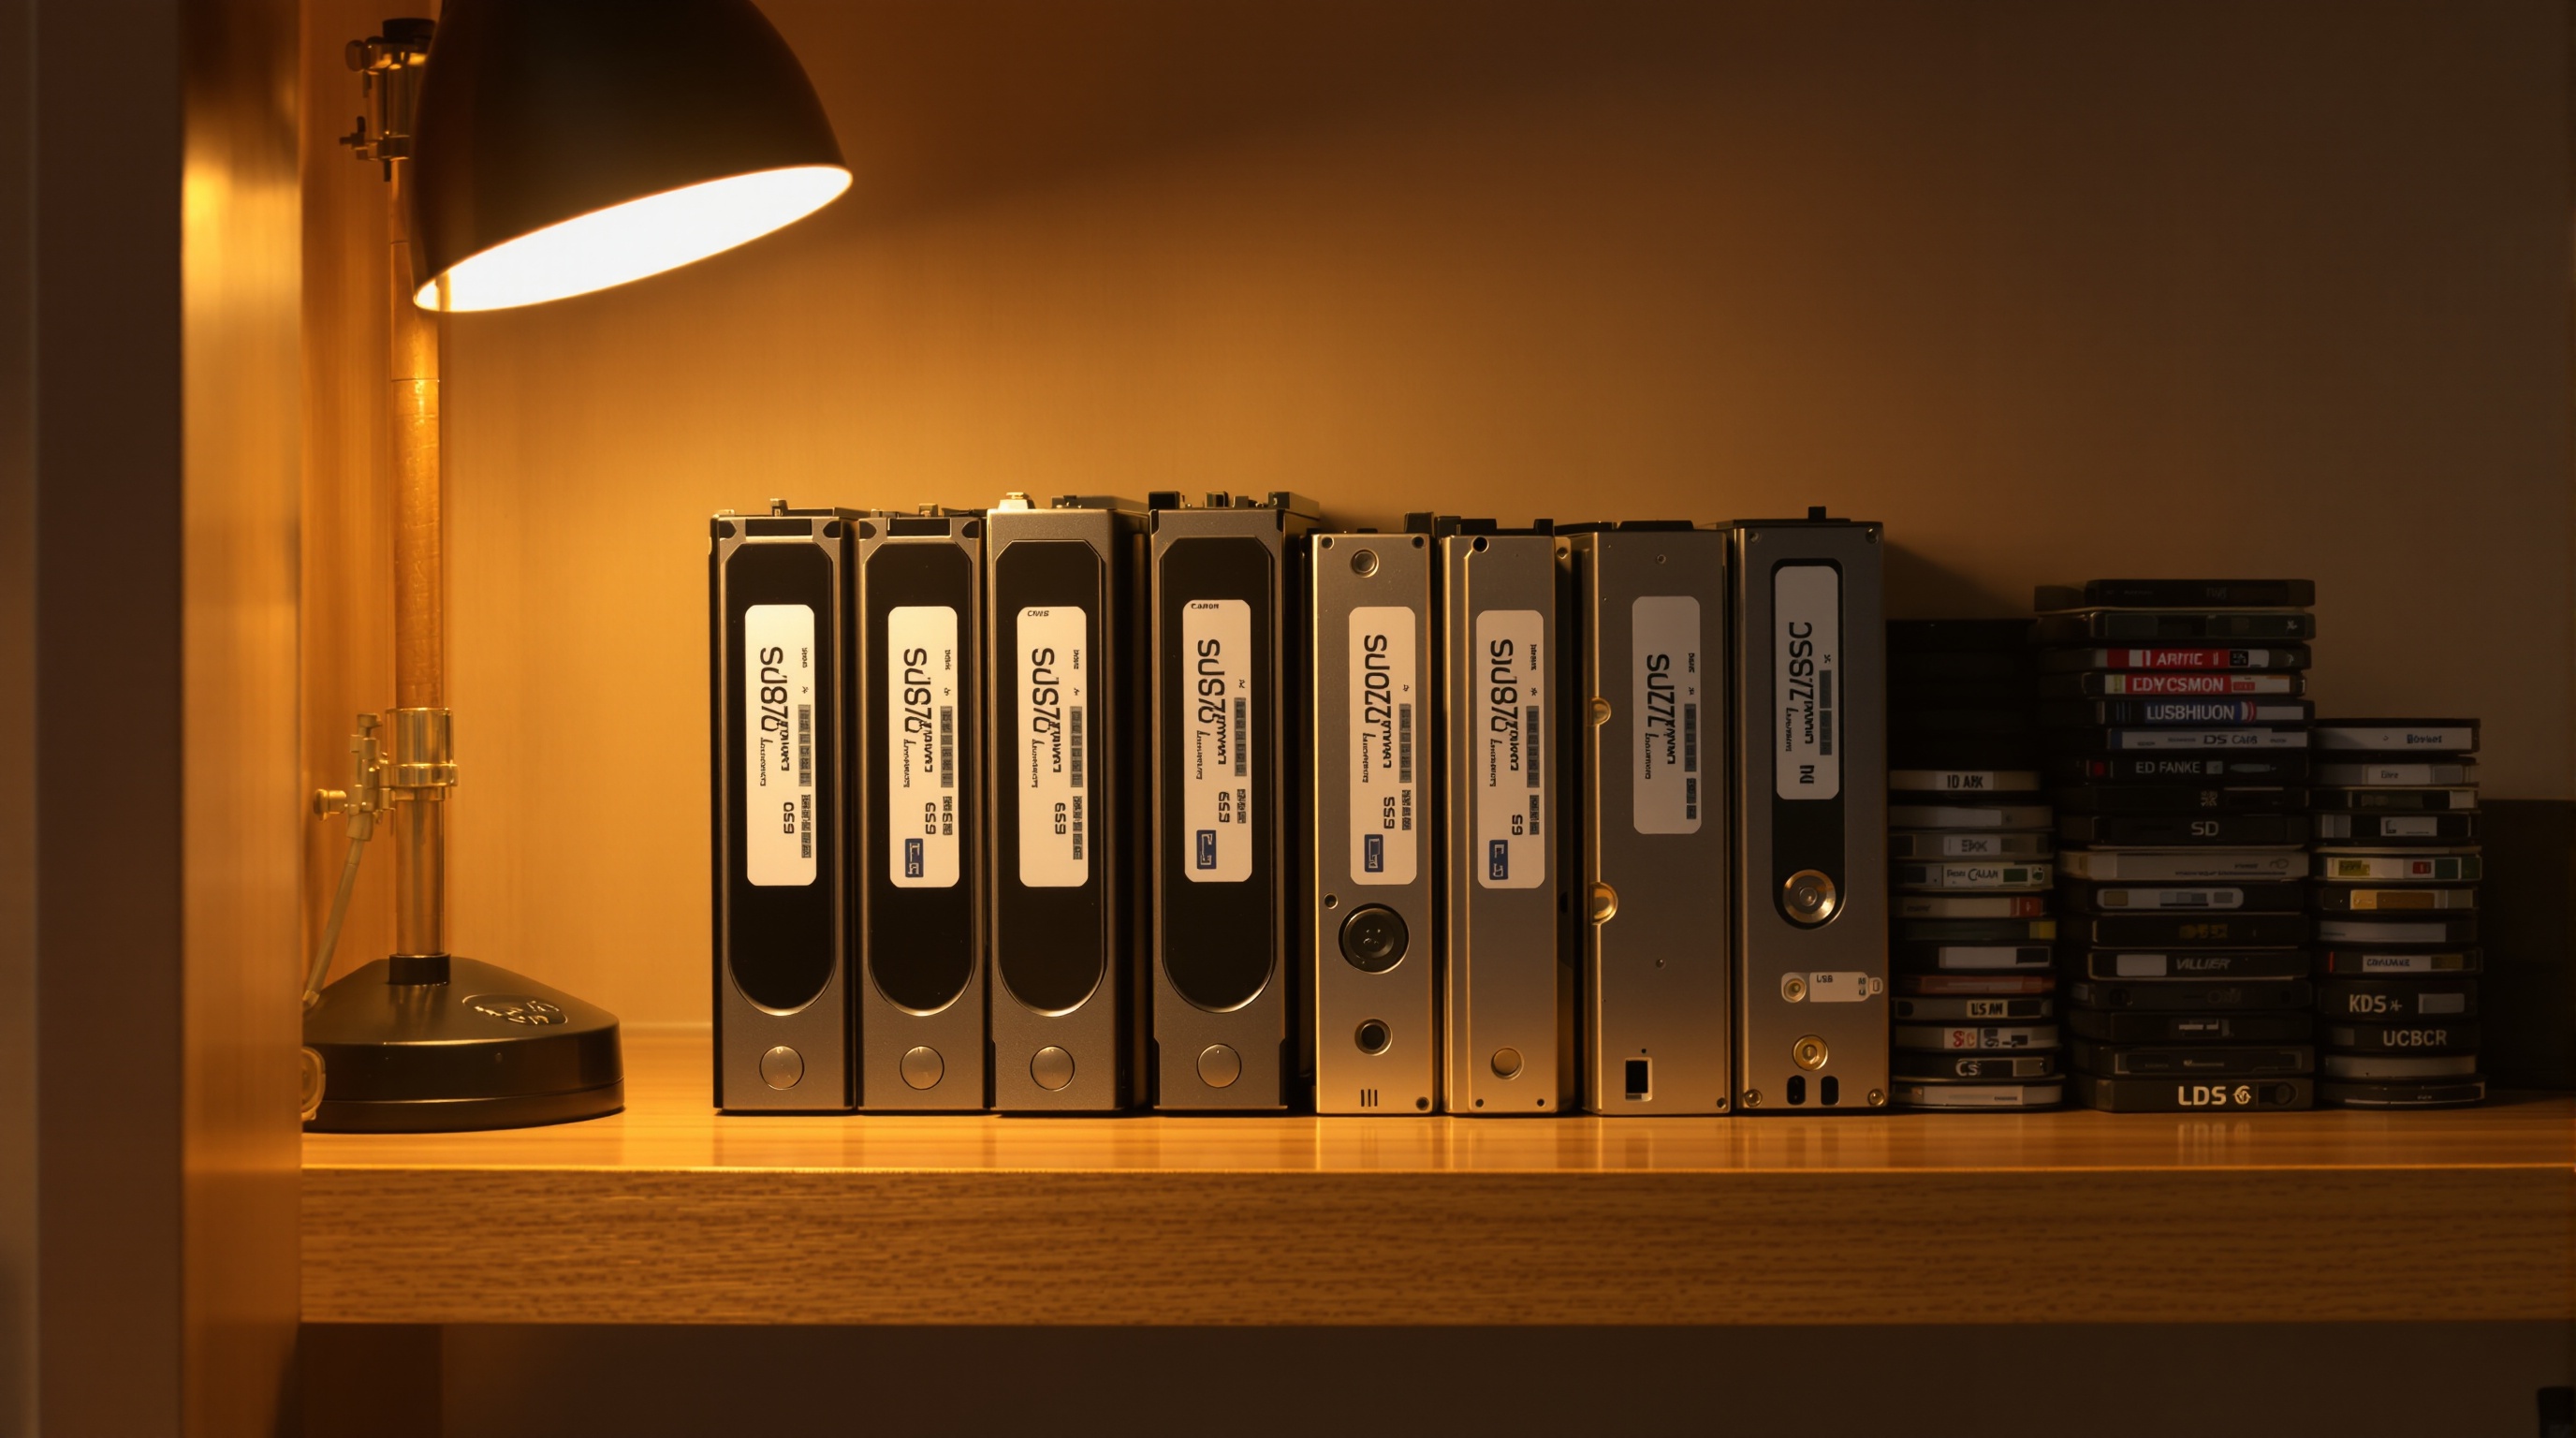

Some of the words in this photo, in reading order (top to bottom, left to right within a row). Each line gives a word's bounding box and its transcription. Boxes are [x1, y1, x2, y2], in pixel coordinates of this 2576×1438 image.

[2203, 735, 2227, 745] DS
[2135, 761, 2155, 774] ED
[2190, 821, 2219, 836] SD
[2349, 993, 2387, 1013] KDS
[2178, 1086, 2227, 1106] LDS
